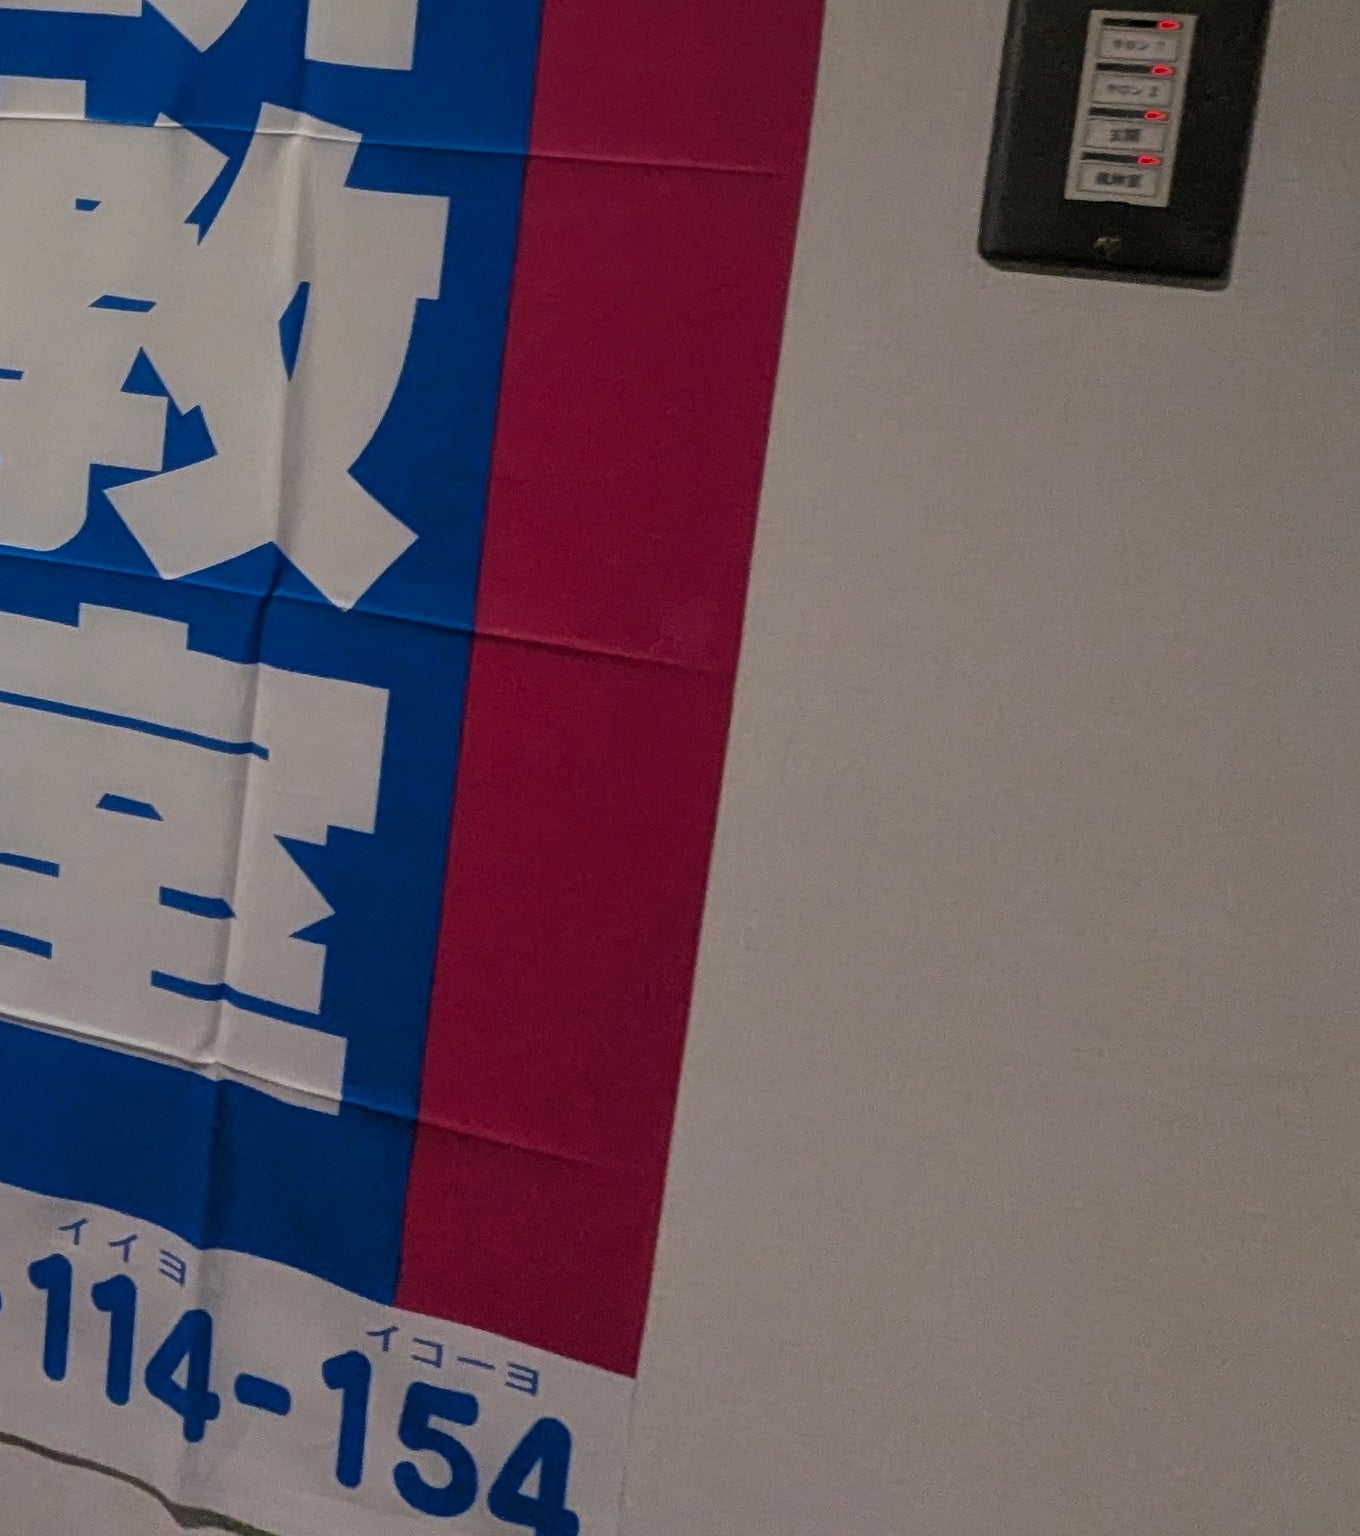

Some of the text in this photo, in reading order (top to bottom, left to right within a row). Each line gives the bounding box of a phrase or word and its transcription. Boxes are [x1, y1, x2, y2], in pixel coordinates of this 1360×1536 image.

[58, 1217, 187, 1285] イイヨ
[365, 1324, 539, 1397] イコーヨ
